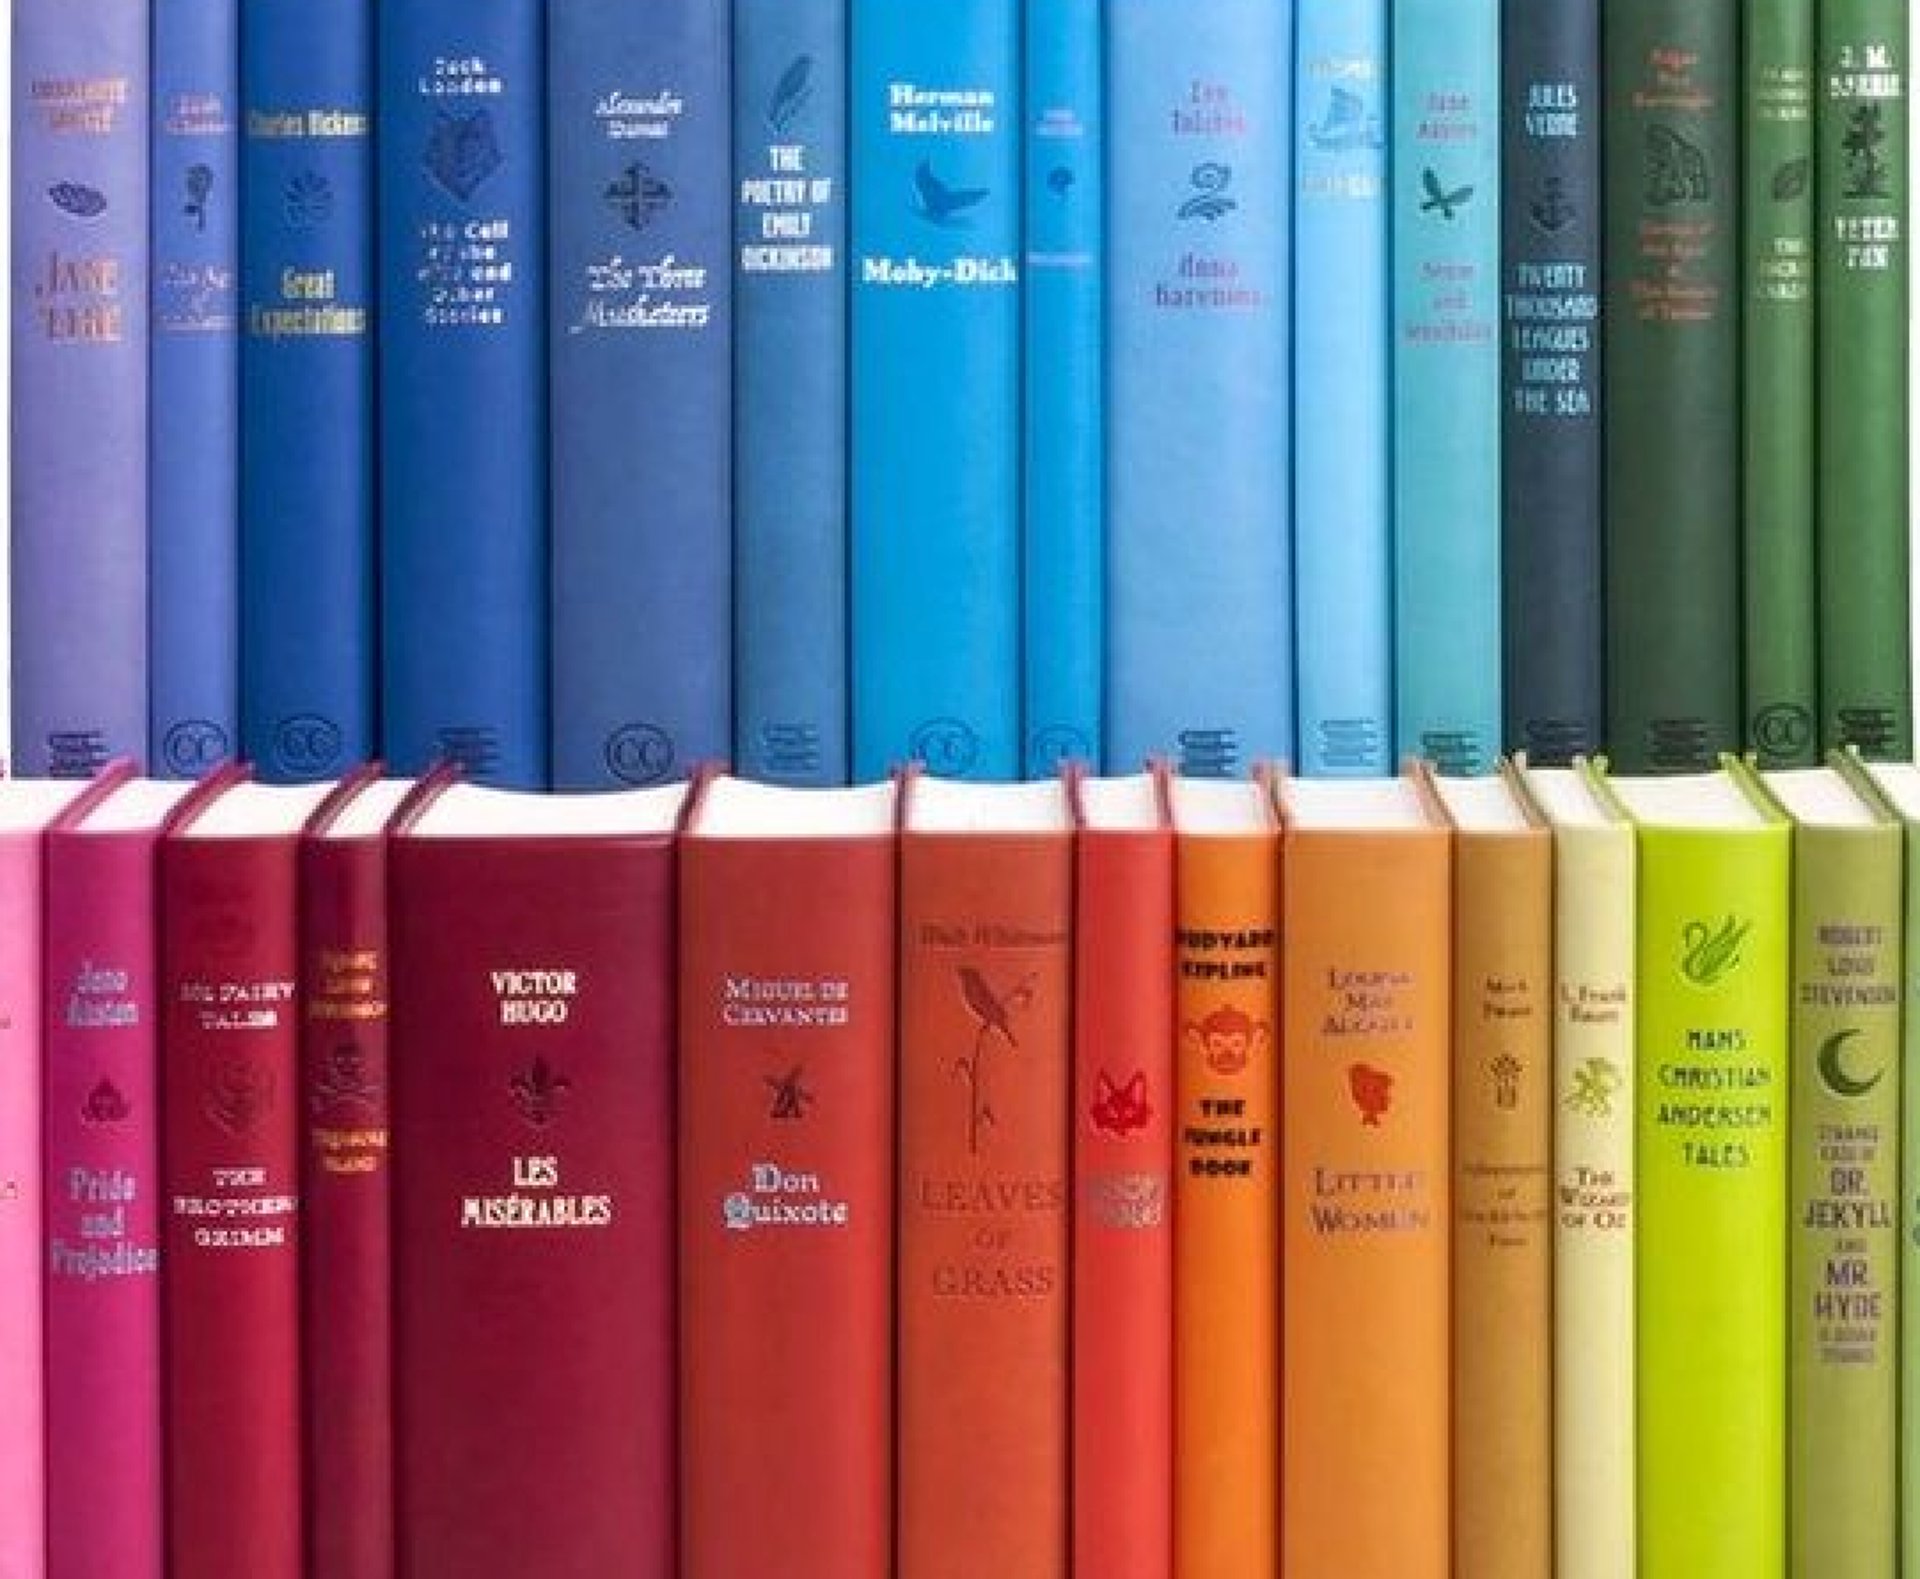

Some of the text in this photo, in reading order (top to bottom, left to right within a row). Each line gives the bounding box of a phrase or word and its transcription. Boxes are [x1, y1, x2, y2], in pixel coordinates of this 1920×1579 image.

[418, 77, 502, 94] London
[888, 83, 995, 107] Herman
[889, 111, 995, 134] Melville
[769, 144, 804, 172] THE
[862, 256, 1018, 289] Moby-Dick
[489, 969, 578, 997] VICTOR
[502, 998, 569, 1026] HUGO
[1656, 1065, 1774, 1089] CHRISTIAN
[1199, 1098, 1247, 1117] THE
[1656, 1104, 1774, 1128] ANDERSEN
[1681, 1142, 1752, 1168] TALES
[512, 1155, 559, 1188] LES
[751, 1162, 820, 1194] Don
[460, 1193, 612, 1230] MISÉRABLES
[722, 1191, 850, 1231] Quixote
